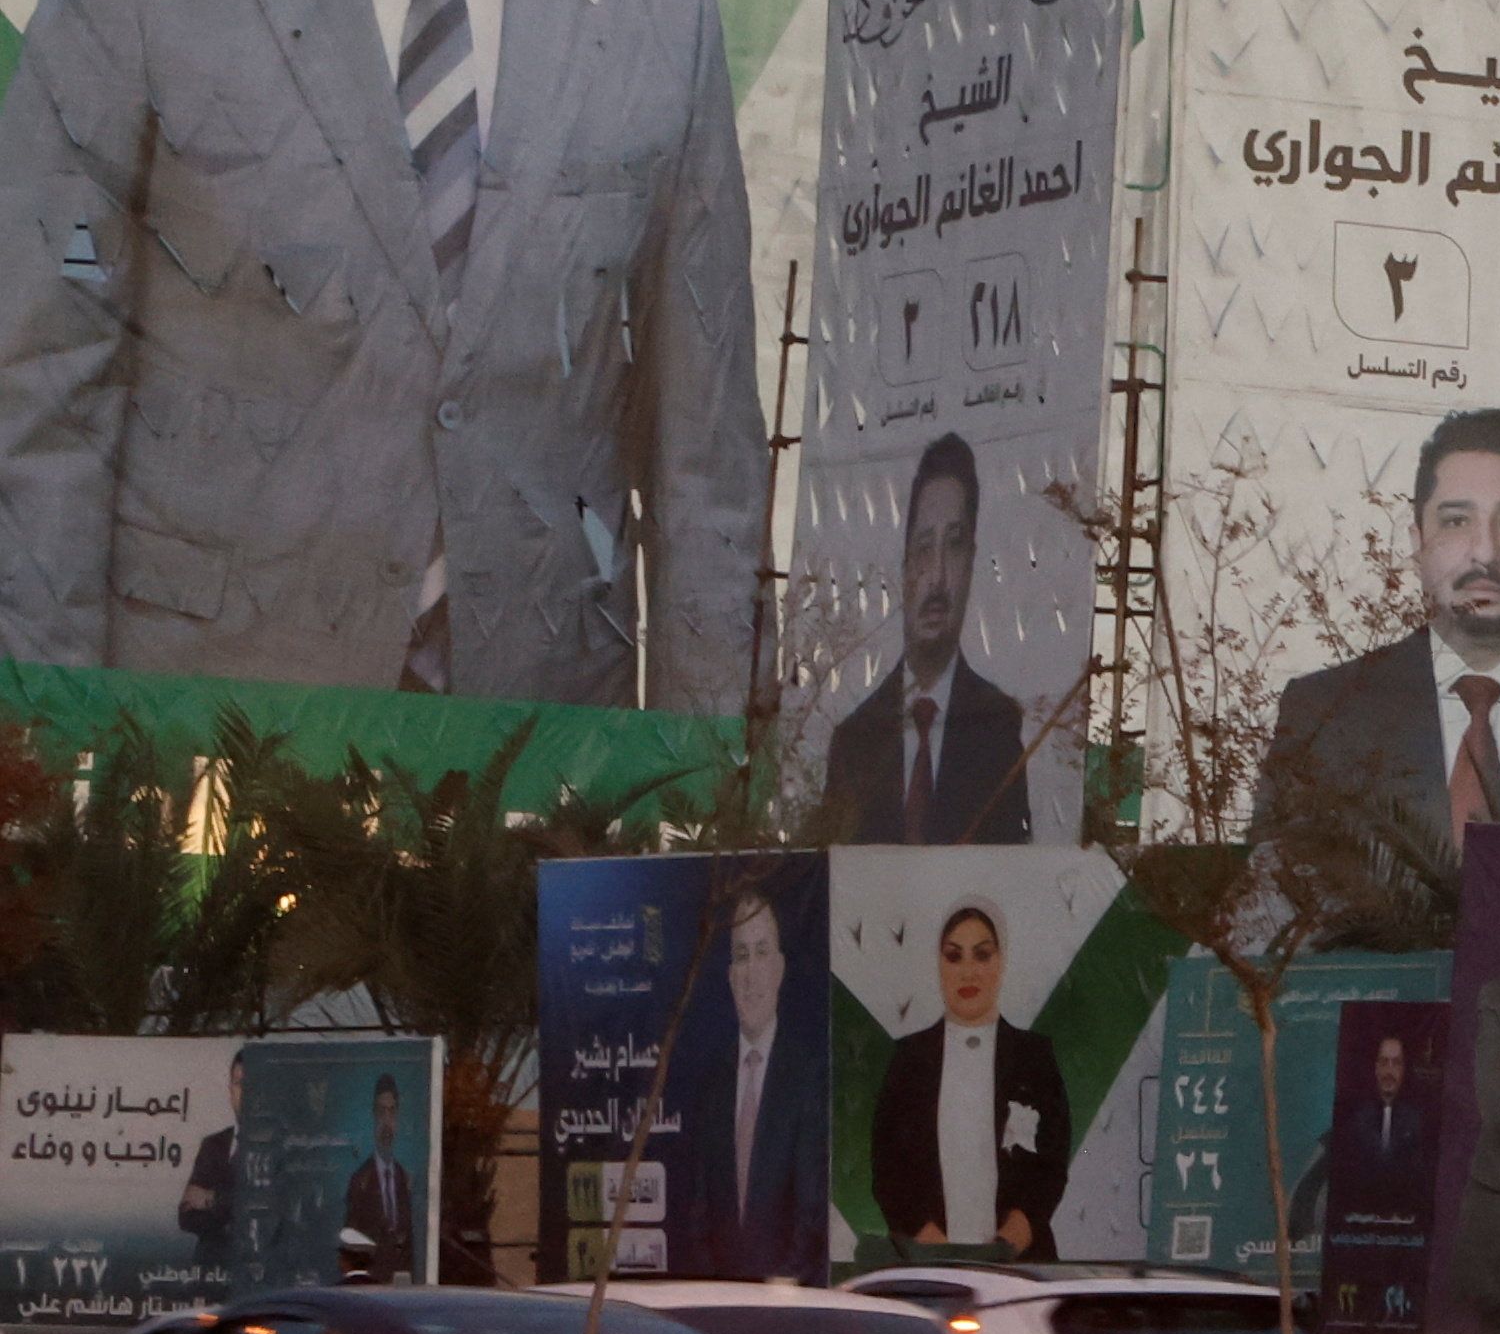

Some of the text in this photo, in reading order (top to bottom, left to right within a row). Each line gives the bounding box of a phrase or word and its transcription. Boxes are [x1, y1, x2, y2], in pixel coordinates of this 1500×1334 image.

[919, 52, 1014, 145] الشيخ
[1242, 118, 1431, 199] الجواري
[842, 140, 1083, 256] احمد الغانم الجواري
[970, 277, 1022, 349] ٢١٨
[1383, 251, 1419, 323] ٣
[1346, 353, 1468, 390] رقم التسلسل
[17, 1083, 98, 1118] نينوى
[1175, 1075, 1230, 1115] ٢٤٤
[10, 1133, 75, 1167] وفاء
